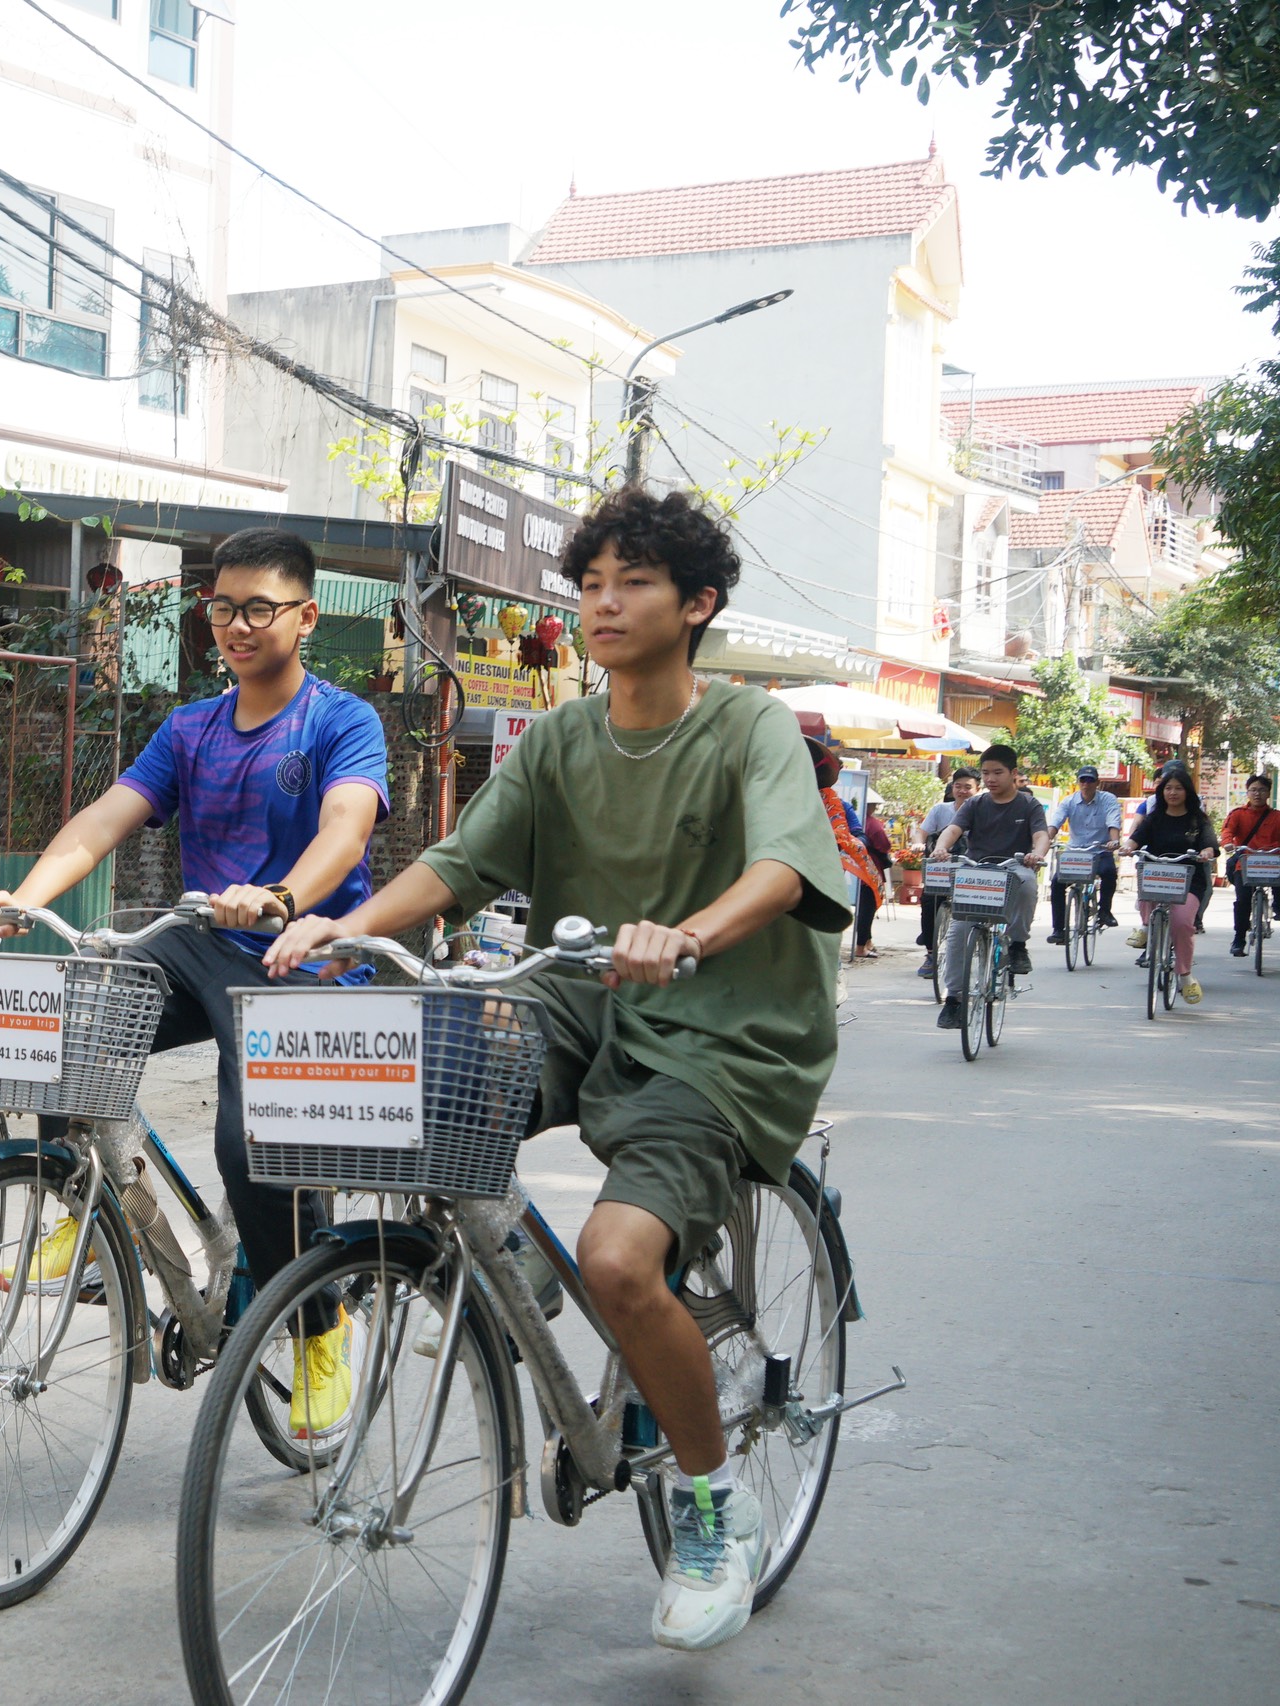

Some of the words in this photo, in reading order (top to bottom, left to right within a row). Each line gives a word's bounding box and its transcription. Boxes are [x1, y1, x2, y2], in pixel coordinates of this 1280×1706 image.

[466, 693, 482, 704] FAST
[487, 695, 507, 707] LUNCH
[511, 698, 532, 709] DINNER
[507, 717, 534, 736] TA
[497, 890, 524, 902] LINE:
[9, 1018, 32, 1029] your
[36, 1017, 56, 1030] trip
[246, 1030, 271, 1058] GO
[275, 1031, 311, 1059] ASIA
[315, 1031, 417, 1060] TRAVEL.COM
[14, 1048, 28, 1061] 15
[29, 1049, 57, 1063] 4646
[251, 1066, 268, 1075] we
[273, 1066, 302, 1076] care
[307, 1065, 345, 1078] about
[350, 1067, 379, 1079] your
[385, 1066, 410, 1080] trip
[248, 1102, 298, 1120] Hotline:
[301, 1104, 325, 1119] +84
[328, 1105, 354, 1120] 941
[358, 1105, 375, 1121] 15
[378, 1106, 413, 1123] 4646
